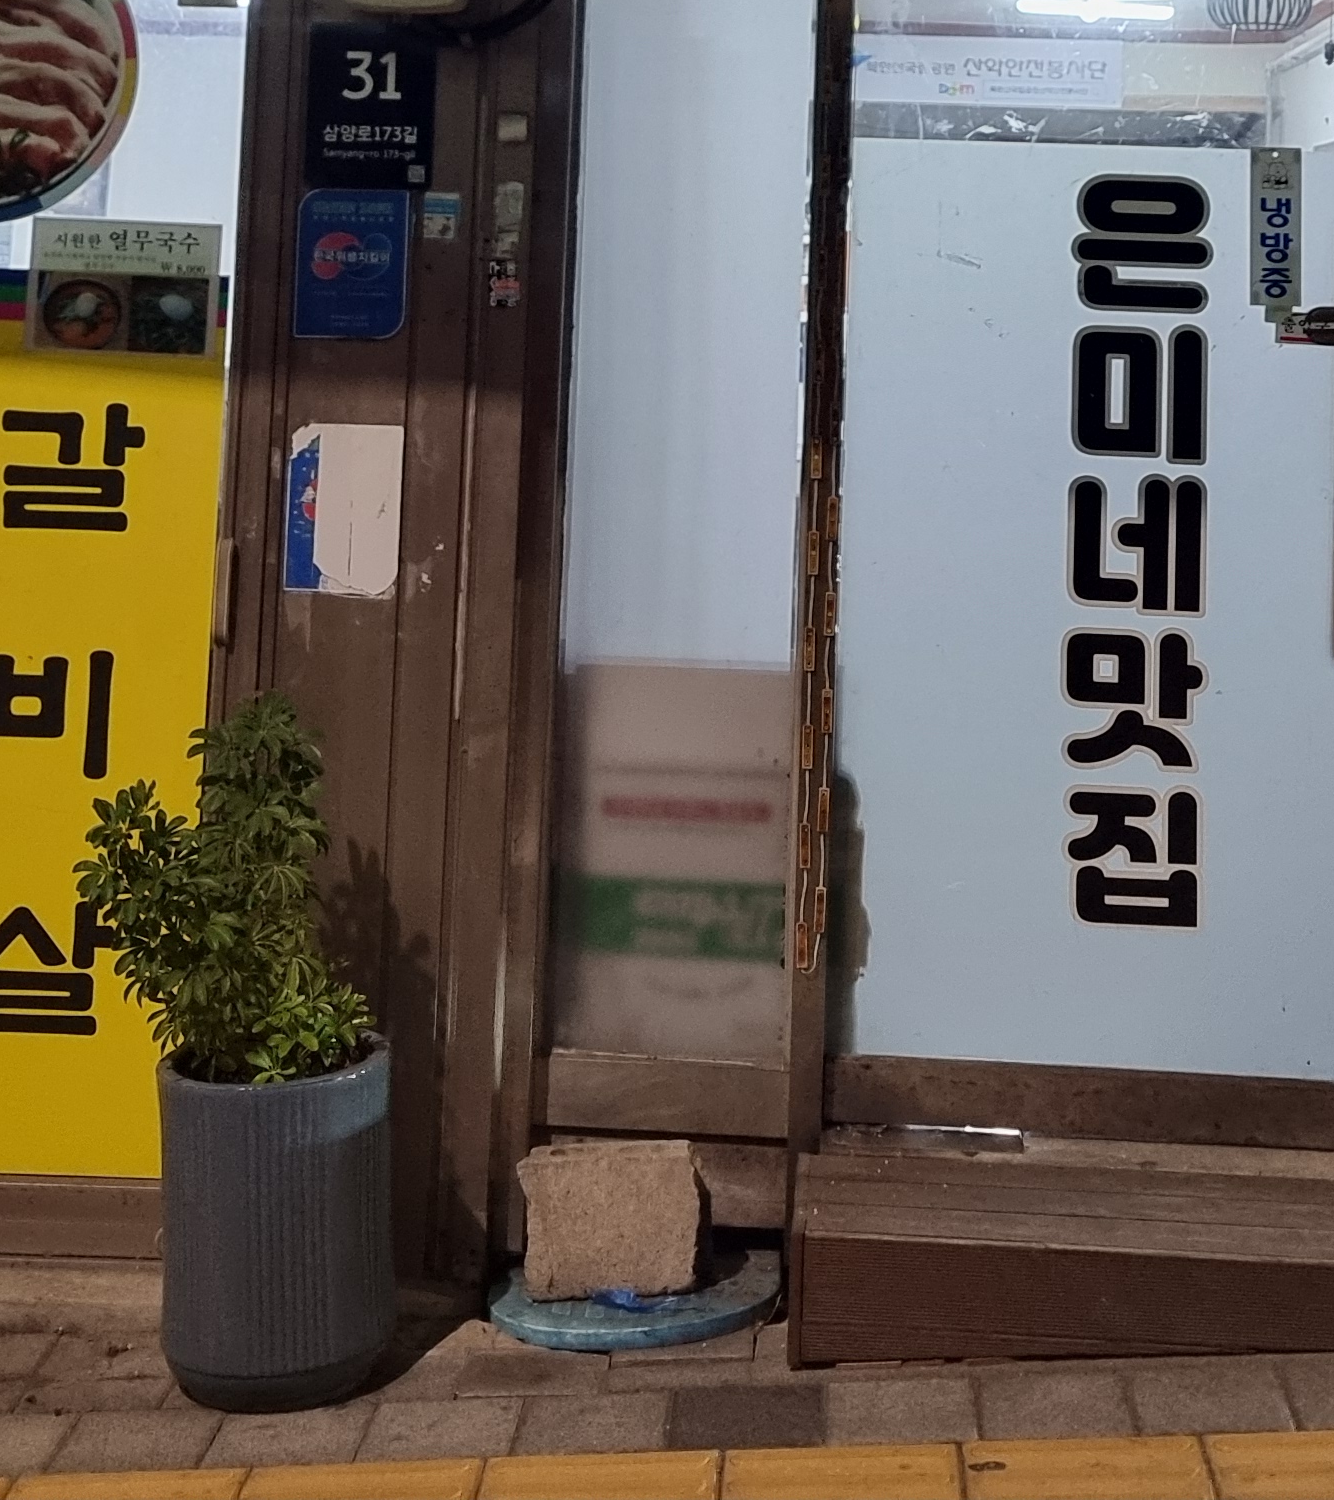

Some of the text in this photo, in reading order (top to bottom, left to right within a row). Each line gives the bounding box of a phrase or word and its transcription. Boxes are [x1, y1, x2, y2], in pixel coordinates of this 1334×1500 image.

[341, 50, 402, 100] 31
[323, 124, 418, 144] 삼양로173길
[54, 228, 201, 255] 시원한 열무국수
[1260, 197, 1294, 299] 냉방중
[1063, 174, 1211, 929] 은미네맛집
